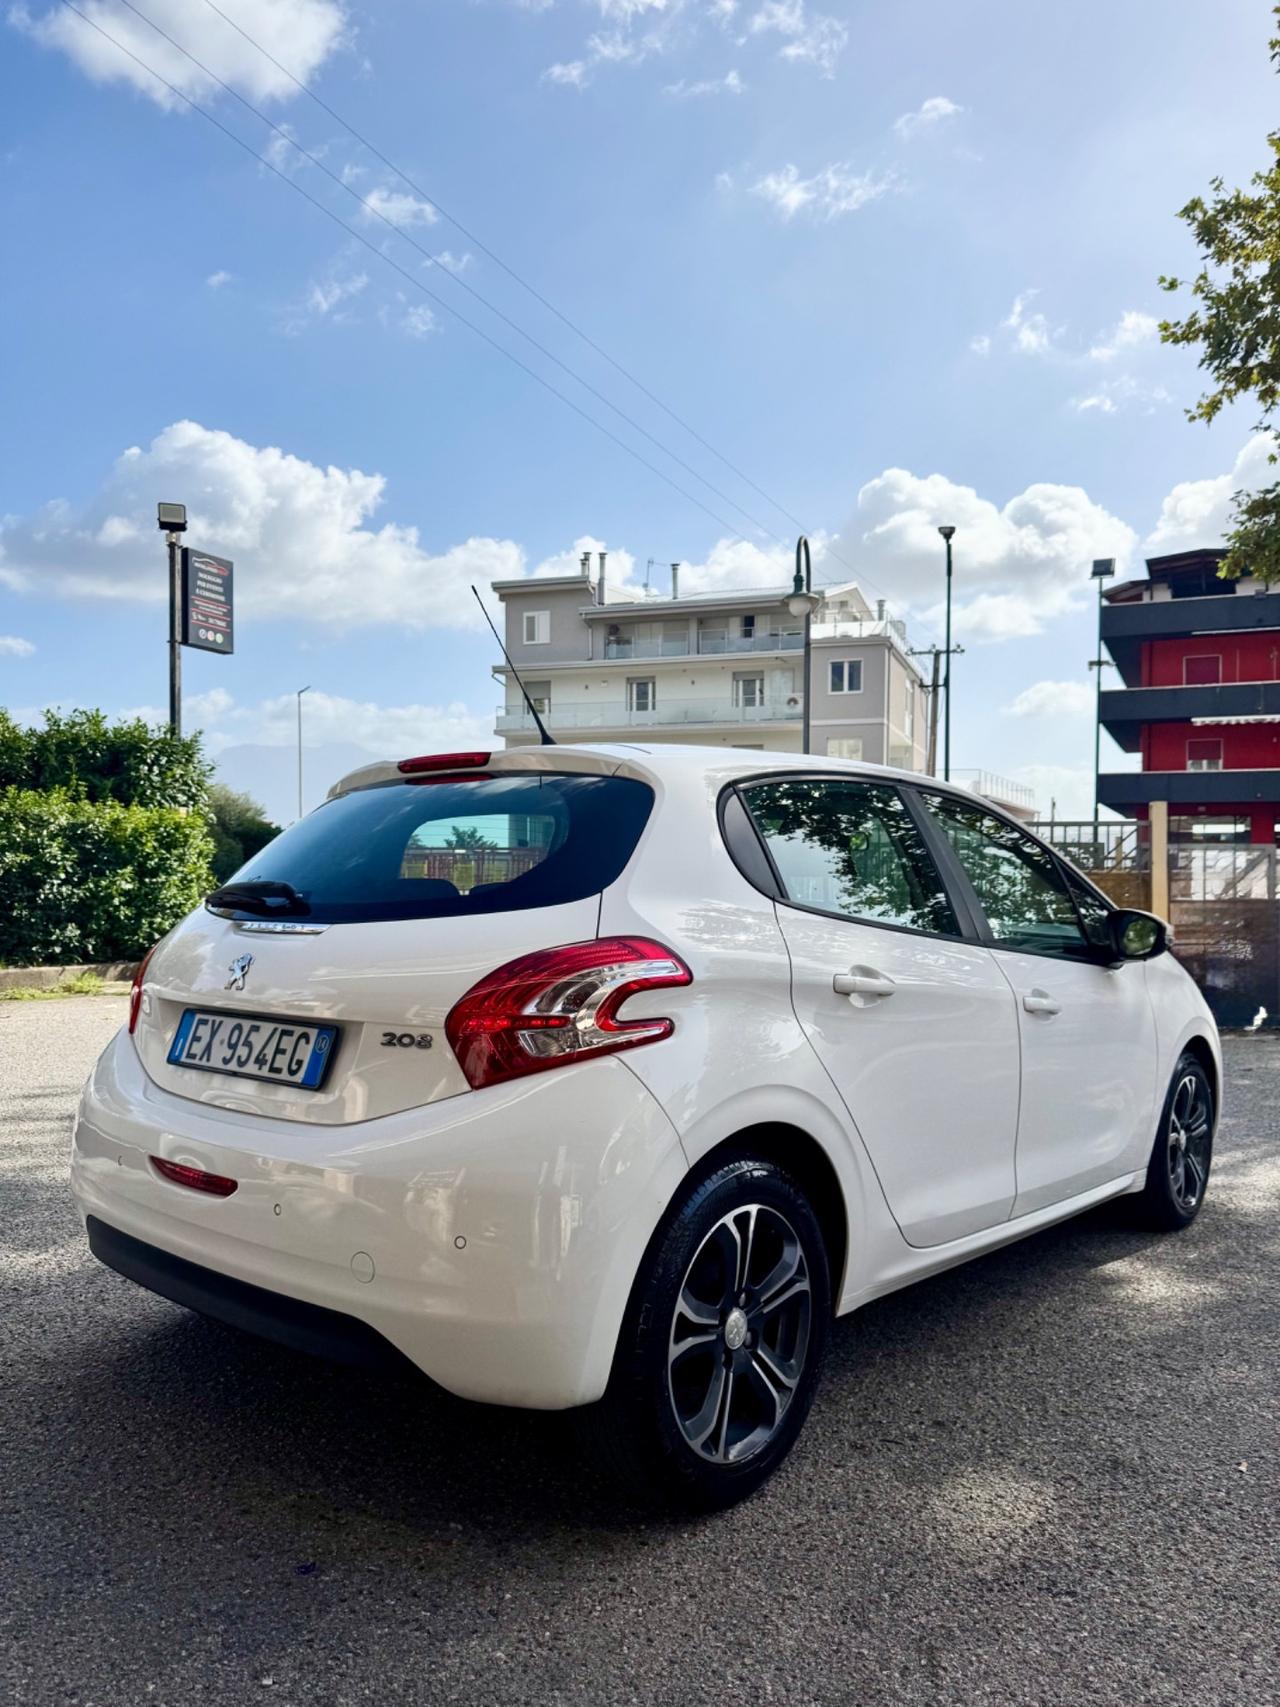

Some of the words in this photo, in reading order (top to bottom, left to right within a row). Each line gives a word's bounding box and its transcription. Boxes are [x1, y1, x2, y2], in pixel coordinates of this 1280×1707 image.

[185, 1018, 223, 1063] EX
[222, 1022, 311, 1077] 954EG
[380, 1032, 433, 1049] 208
